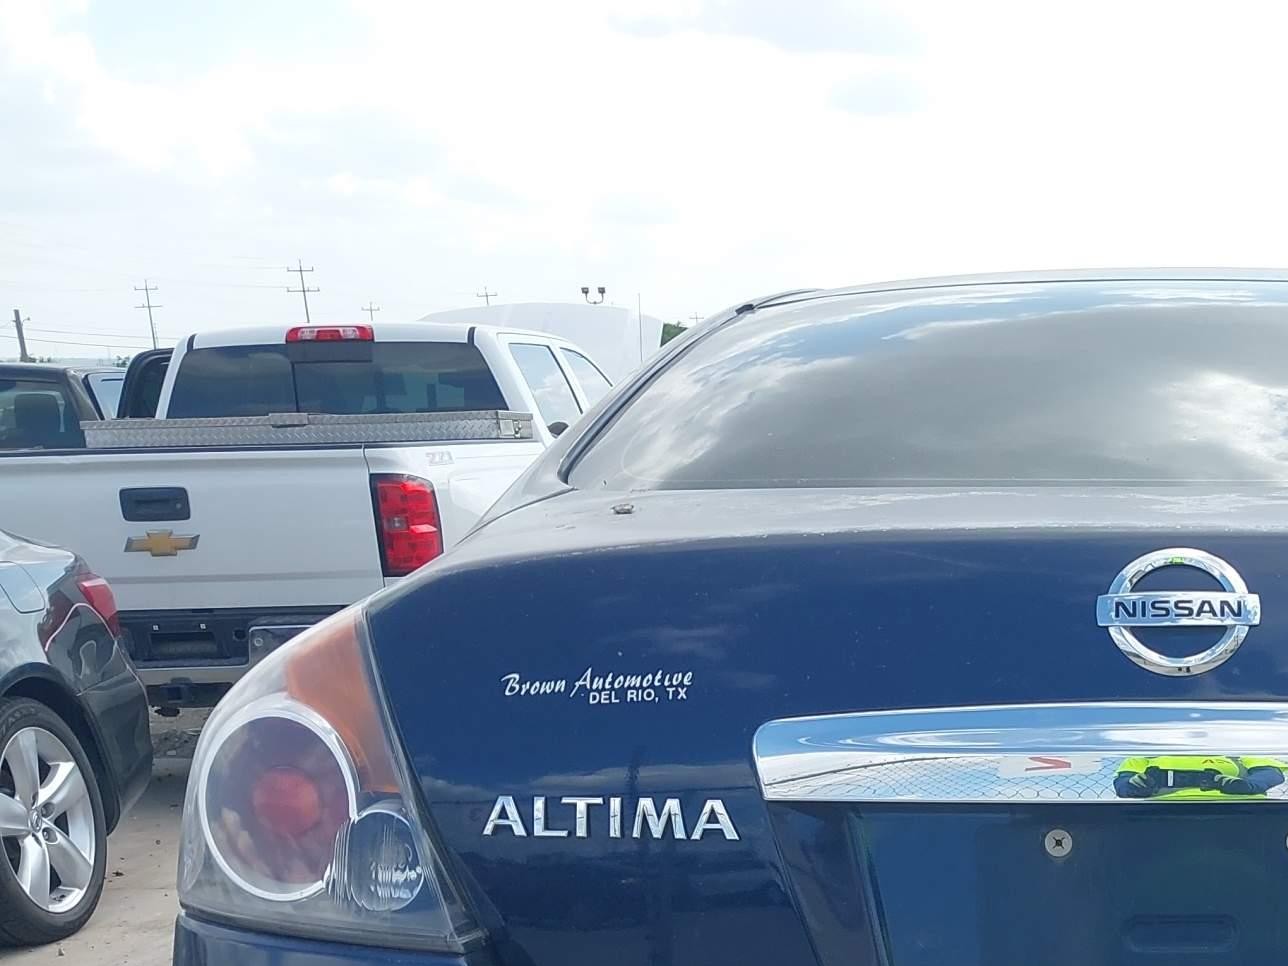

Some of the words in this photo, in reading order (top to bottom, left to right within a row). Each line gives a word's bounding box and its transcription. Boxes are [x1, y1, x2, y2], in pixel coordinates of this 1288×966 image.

[1114, 600, 1242, 618] NISSAN
[501, 673, 566, 696] Brown
[570, 667, 693, 698] Automotive
[589, 692, 620, 704] DEL
[627, 689, 659, 703] RIO,
[667, 687, 687, 700] TX
[482, 795, 740, 841] ALTIMA
